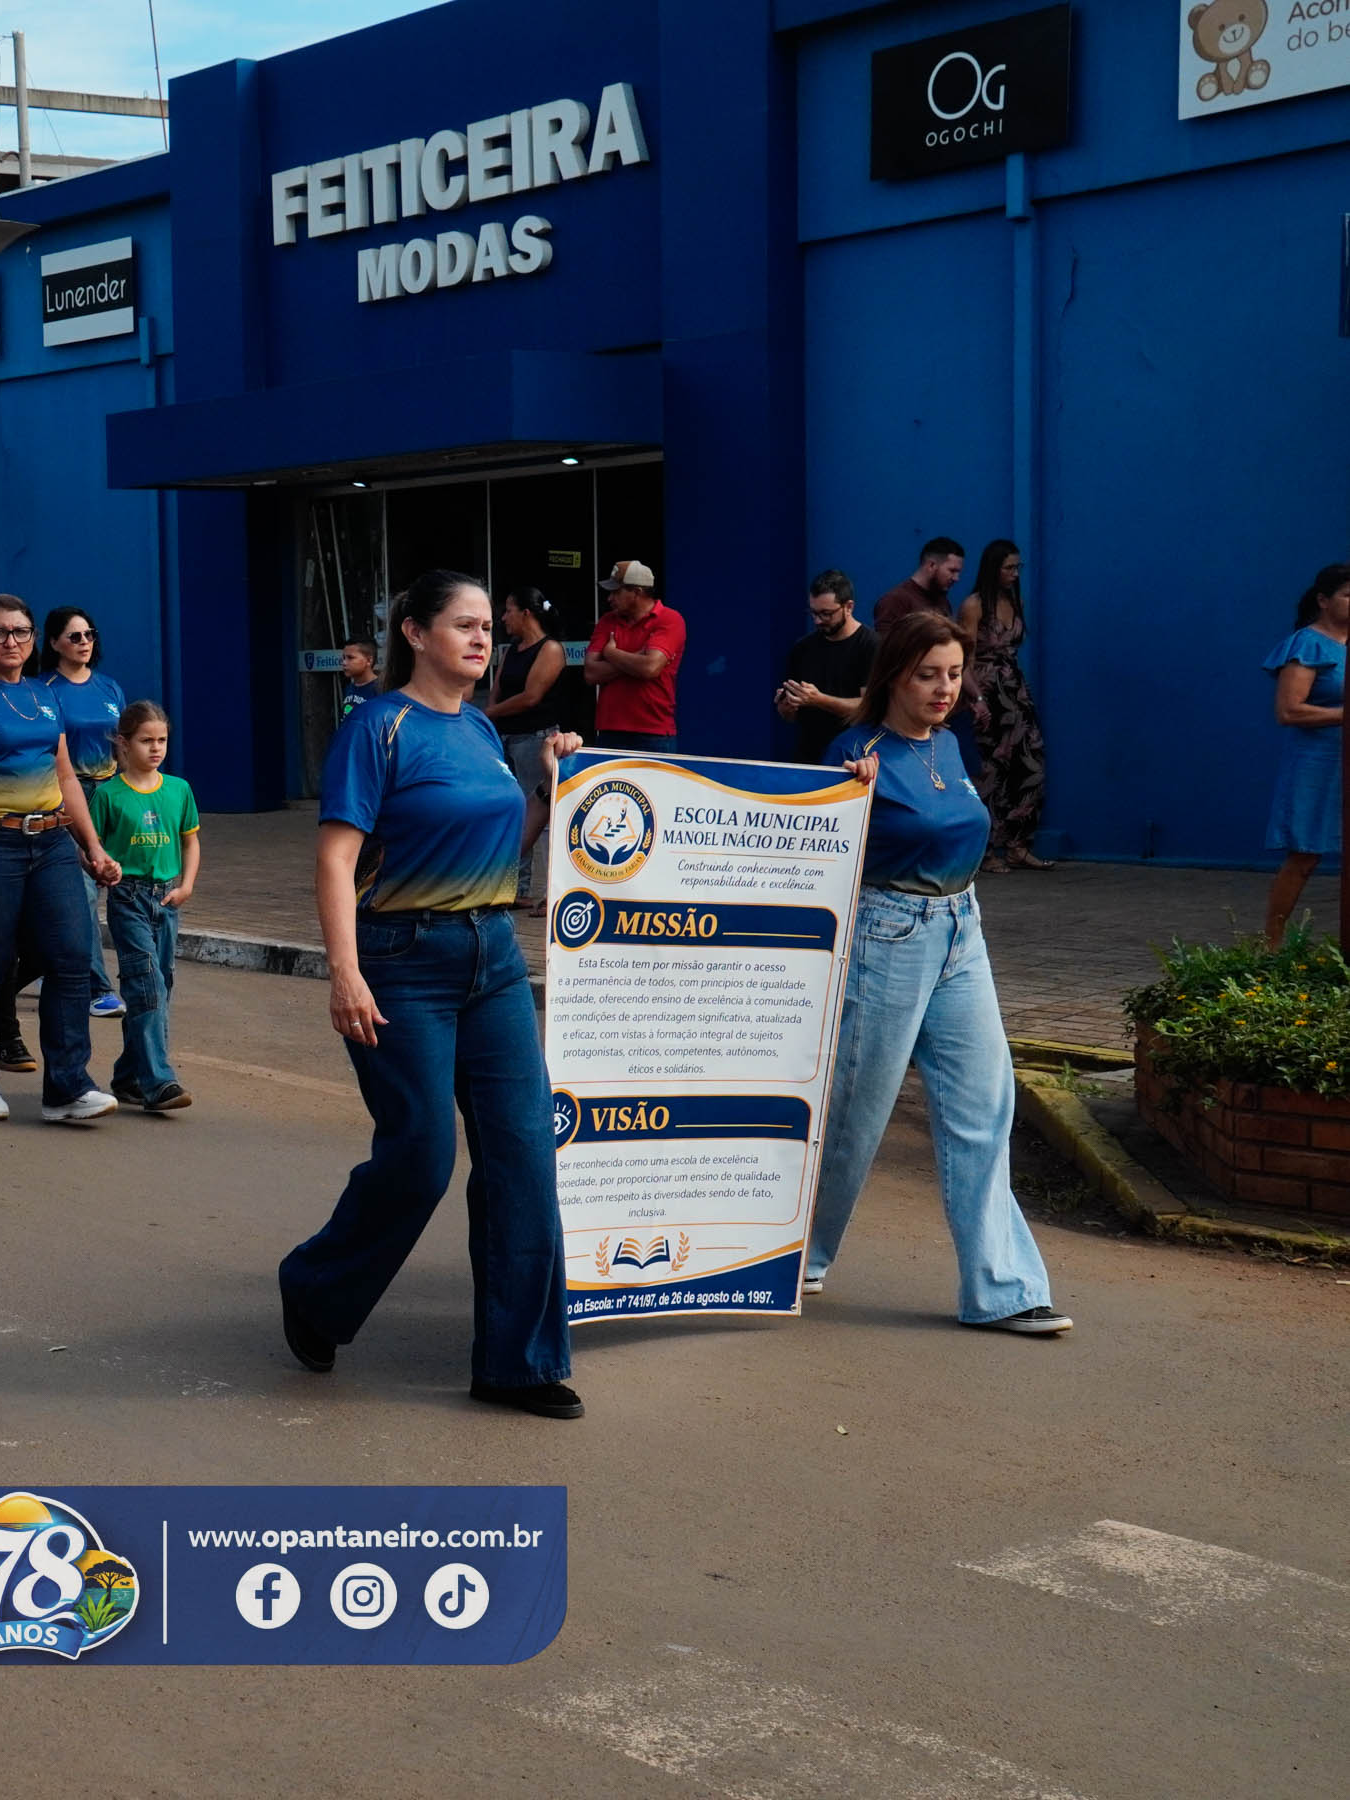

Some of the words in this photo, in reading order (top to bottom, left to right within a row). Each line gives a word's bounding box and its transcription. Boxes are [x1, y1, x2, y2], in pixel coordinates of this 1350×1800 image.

[1287, 28, 1318, 51] do
[925, 119, 1003, 148] OGOCHI
[271, 82, 650, 246] FEITICEIRA
[358, 215, 553, 303] MODAS
[46, 273, 127, 313] Lunender
[580, 784, 609, 813] ESCOLA
[611, 782, 651, 816] MUNICIPAL
[674, 807, 738, 827] ESCOLA
[744, 812, 840, 833] MUNICIPAL
[130, 833, 171, 846] BONITO
[662, 829, 719, 847] MANOEL
[722, 830, 772, 849] INÁCIO
[776, 836, 796, 850] DE
[800, 838, 850, 854] FARIAS
[678, 859, 734, 873] Construindo
[737, 862, 801, 877] conhecimento
[804, 868, 825, 877] com
[680, 876, 758, 890] responsabilidade
[761, 881, 766, 889] e
[614, 907, 718, 938] MISSÃO
[578, 957, 598, 968] Esta
[600, 957, 629, 969] Escola
[632, 960, 651, 969] tem
[652, 961, 670, 971] por
[672, 960, 704, 970] missão
[706, 961, 742, 973] garantir
[745, 963, 751, 971] o
[754, 963, 786, 972] acesso
[558, 978, 563, 986] e
[565, 978, 571, 986] a
[573, 976, 631, 988] permanência
[634, 976, 647, 986] de
[649, 977, 676, 987] todos,
[679, 979, 698, 987] com
[746, 979, 758, 988] de
[760, 979, 806, 991] igualdade
[599, 994, 650, 1004] oferecendo
[651, 995, 681, 1004] ensino
[683, 994, 696, 1004] de
[698, 994, 744, 1005] excelência
[754, 997, 814, 1008] comunidade,
[554, 1014, 569, 1022] com
[571, 1012, 616, 1023] condições
[618, 1012, 630, 1021] de
[632, 1012, 696, 1024] aprendizagem
[698, 1012, 752, 1024] significativa,
[755, 1013, 802, 1024] atualizada
[562, 1031, 568, 1039] e
[570, 1029, 597, 1040] eficaz,
[600, 1031, 619, 1039] com
[621, 1029, 647, 1039] vistas
[656, 1029, 697, 1041] formação
[699, 1030, 733, 1041] integral
[735, 1030, 747, 1039] de
[750, 1031, 783, 1042] sujeitos
[563, 1047, 625, 1059] protagonistas,
[664, 1047, 723, 1058] competentes,
[725, 1046, 779, 1057] autônomos,
[628, 1064, 654, 1074] éticos
[664, 1063, 706, 1074] solidários.
[591, 1101, 670, 1132] VISÃO
[573, 1158, 623, 1169] reconhecida
[625, 1158, 648, 1167] como
[650, 1158, 669, 1166] uma
[671, 1155, 697, 1165] escola
[699, 1155, 710, 1165] de
[712, 1154, 759, 1165] excelência
[600, 1177, 615, 1187] por
[617, 1173, 672, 1186] proporcionar
[674, 1174, 688, 1182] um
[690, 1172, 718, 1181] ensino
[721, 1171, 732, 1181] de
[734, 1171, 781, 1182] qualidade
[585, 1194, 604, 1204] com
[605, 1191, 640, 1203] respeito
[654, 1188, 706, 1200] diversidades
[708, 1188, 735, 1199] sendo
[738, 1187, 749, 1198] de
[752, 1187, 774, 1199] fato,
[628, 1207, 667, 1218] inclusiva.
[574, 1300, 584, 1313] da
[584, 1297, 614, 1312] Escola:
[616, 1295, 627, 1308] nº
[628, 1294, 657, 1308] 741/97,
[659, 1293, 669, 1305] de
[671, 1292, 682, 1304] 26
[683, 1291, 695, 1303] de
[696, 1291, 729, 1305] agosto
[732, 1290, 744, 1303] de
[748, 1290, 774, 1304] 1997.
